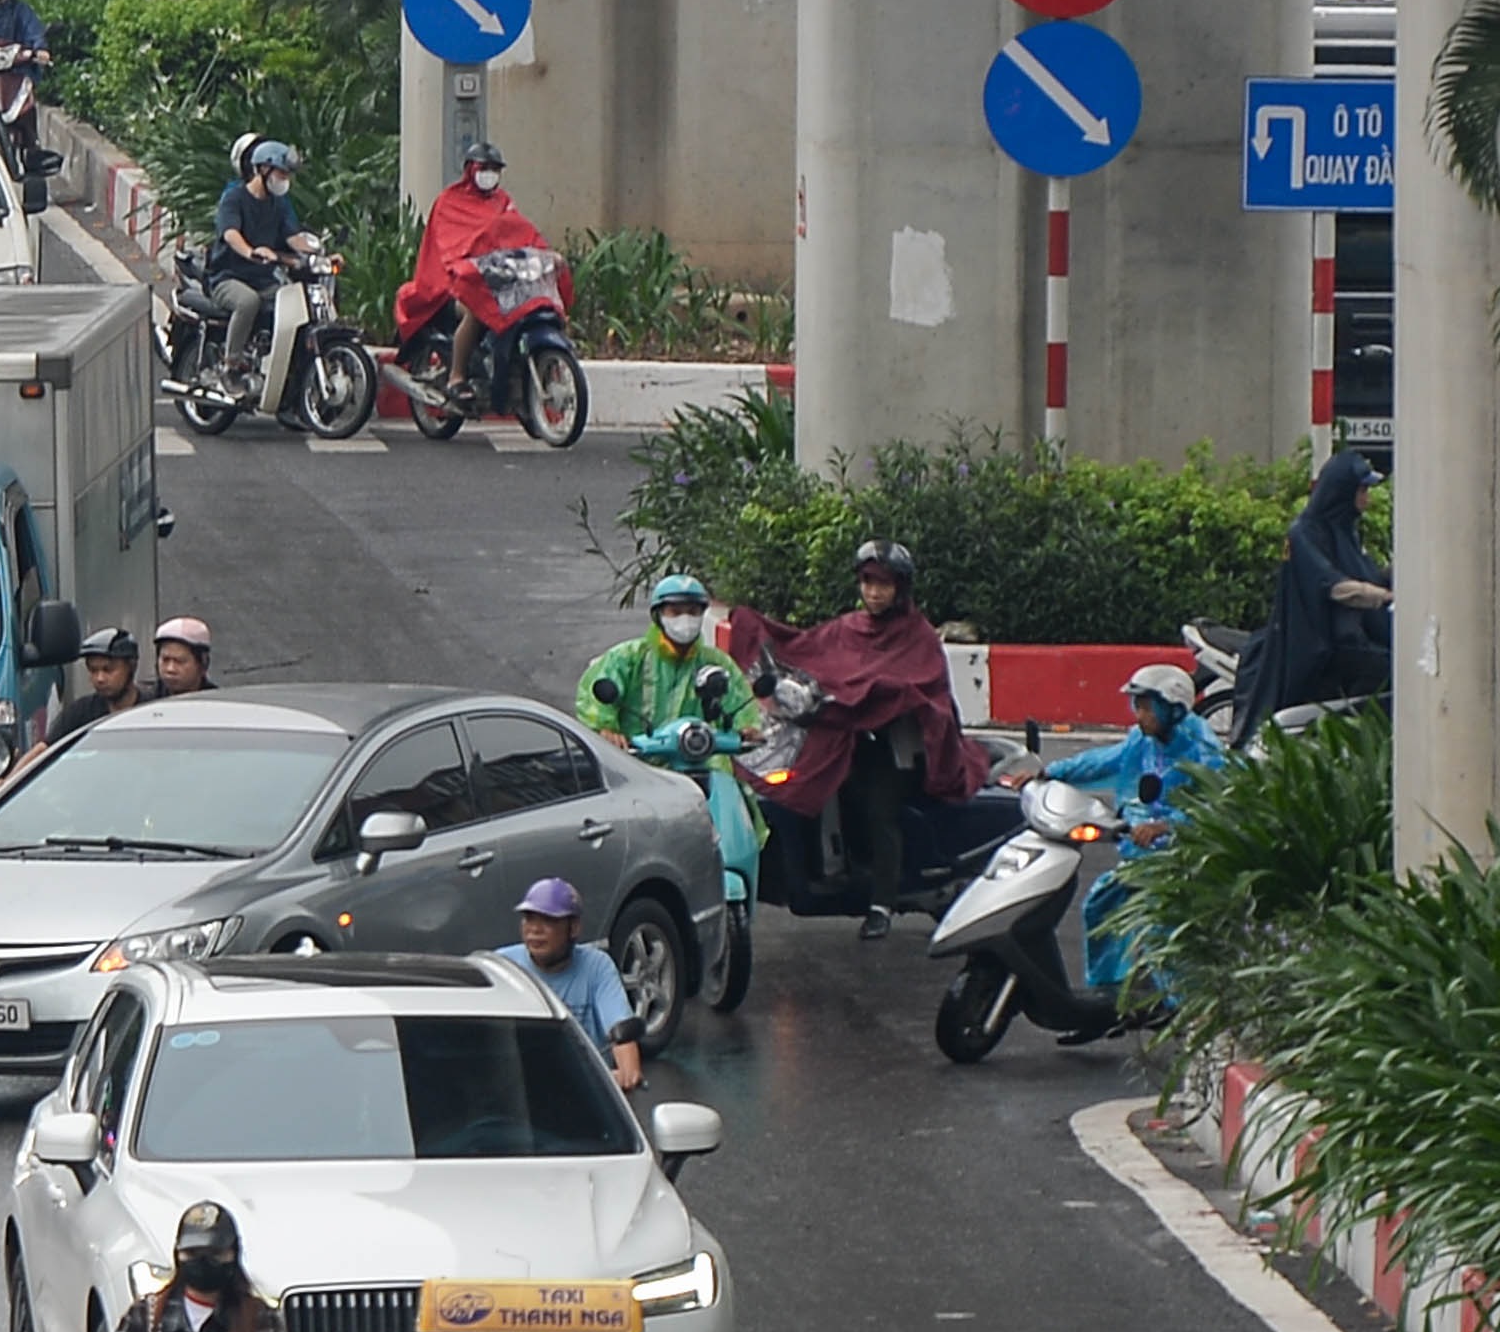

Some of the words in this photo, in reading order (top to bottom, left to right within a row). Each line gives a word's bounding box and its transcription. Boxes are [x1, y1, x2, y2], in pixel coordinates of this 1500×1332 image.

[1334, 103, 1349, 138] Ô
[1356, 103, 1383, 138] TÔ
[1305, 155, 1359, 184] QUAY
[539, 1288, 585, 1305] TAXI
[499, 1309, 573, 1326] THANH
[581, 1309, 624, 1326] NGA
